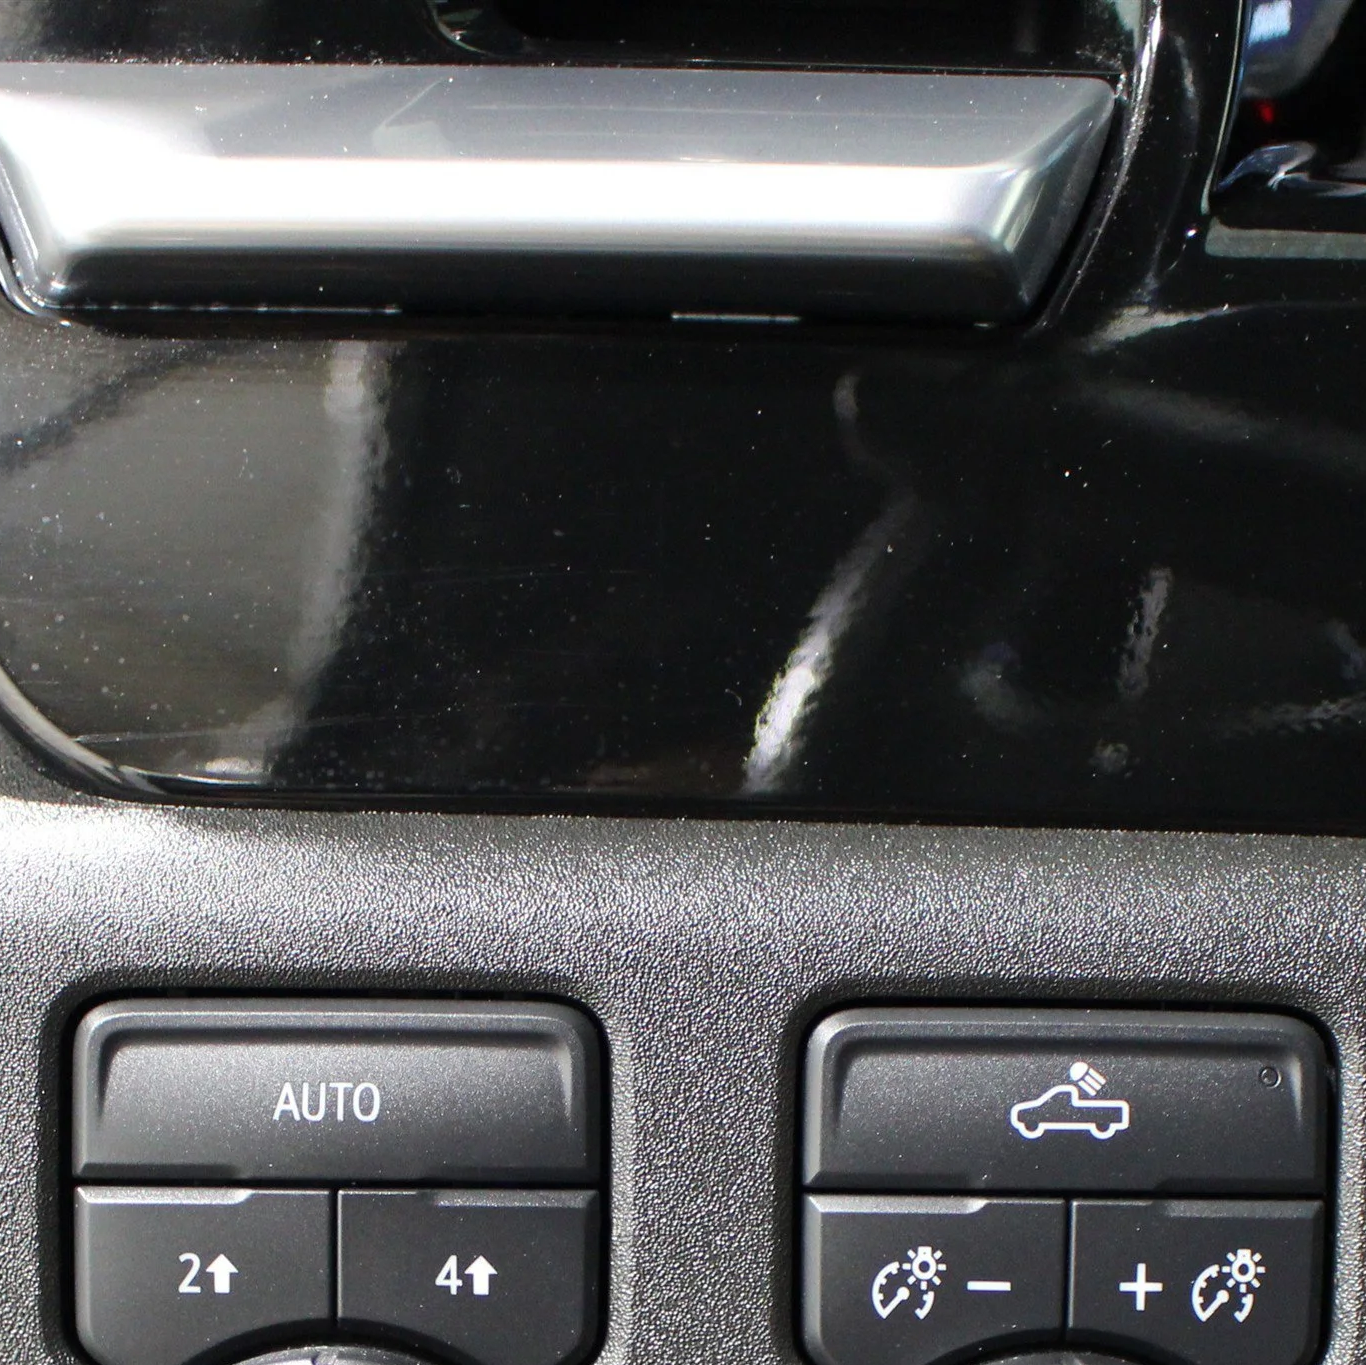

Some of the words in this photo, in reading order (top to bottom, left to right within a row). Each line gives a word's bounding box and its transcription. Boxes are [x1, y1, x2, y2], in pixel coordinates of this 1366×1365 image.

[272, 1082, 381, 1123] AUTO
[177, 1251, 203, 1294] 2
[434, 1253, 464, 1296] 4
